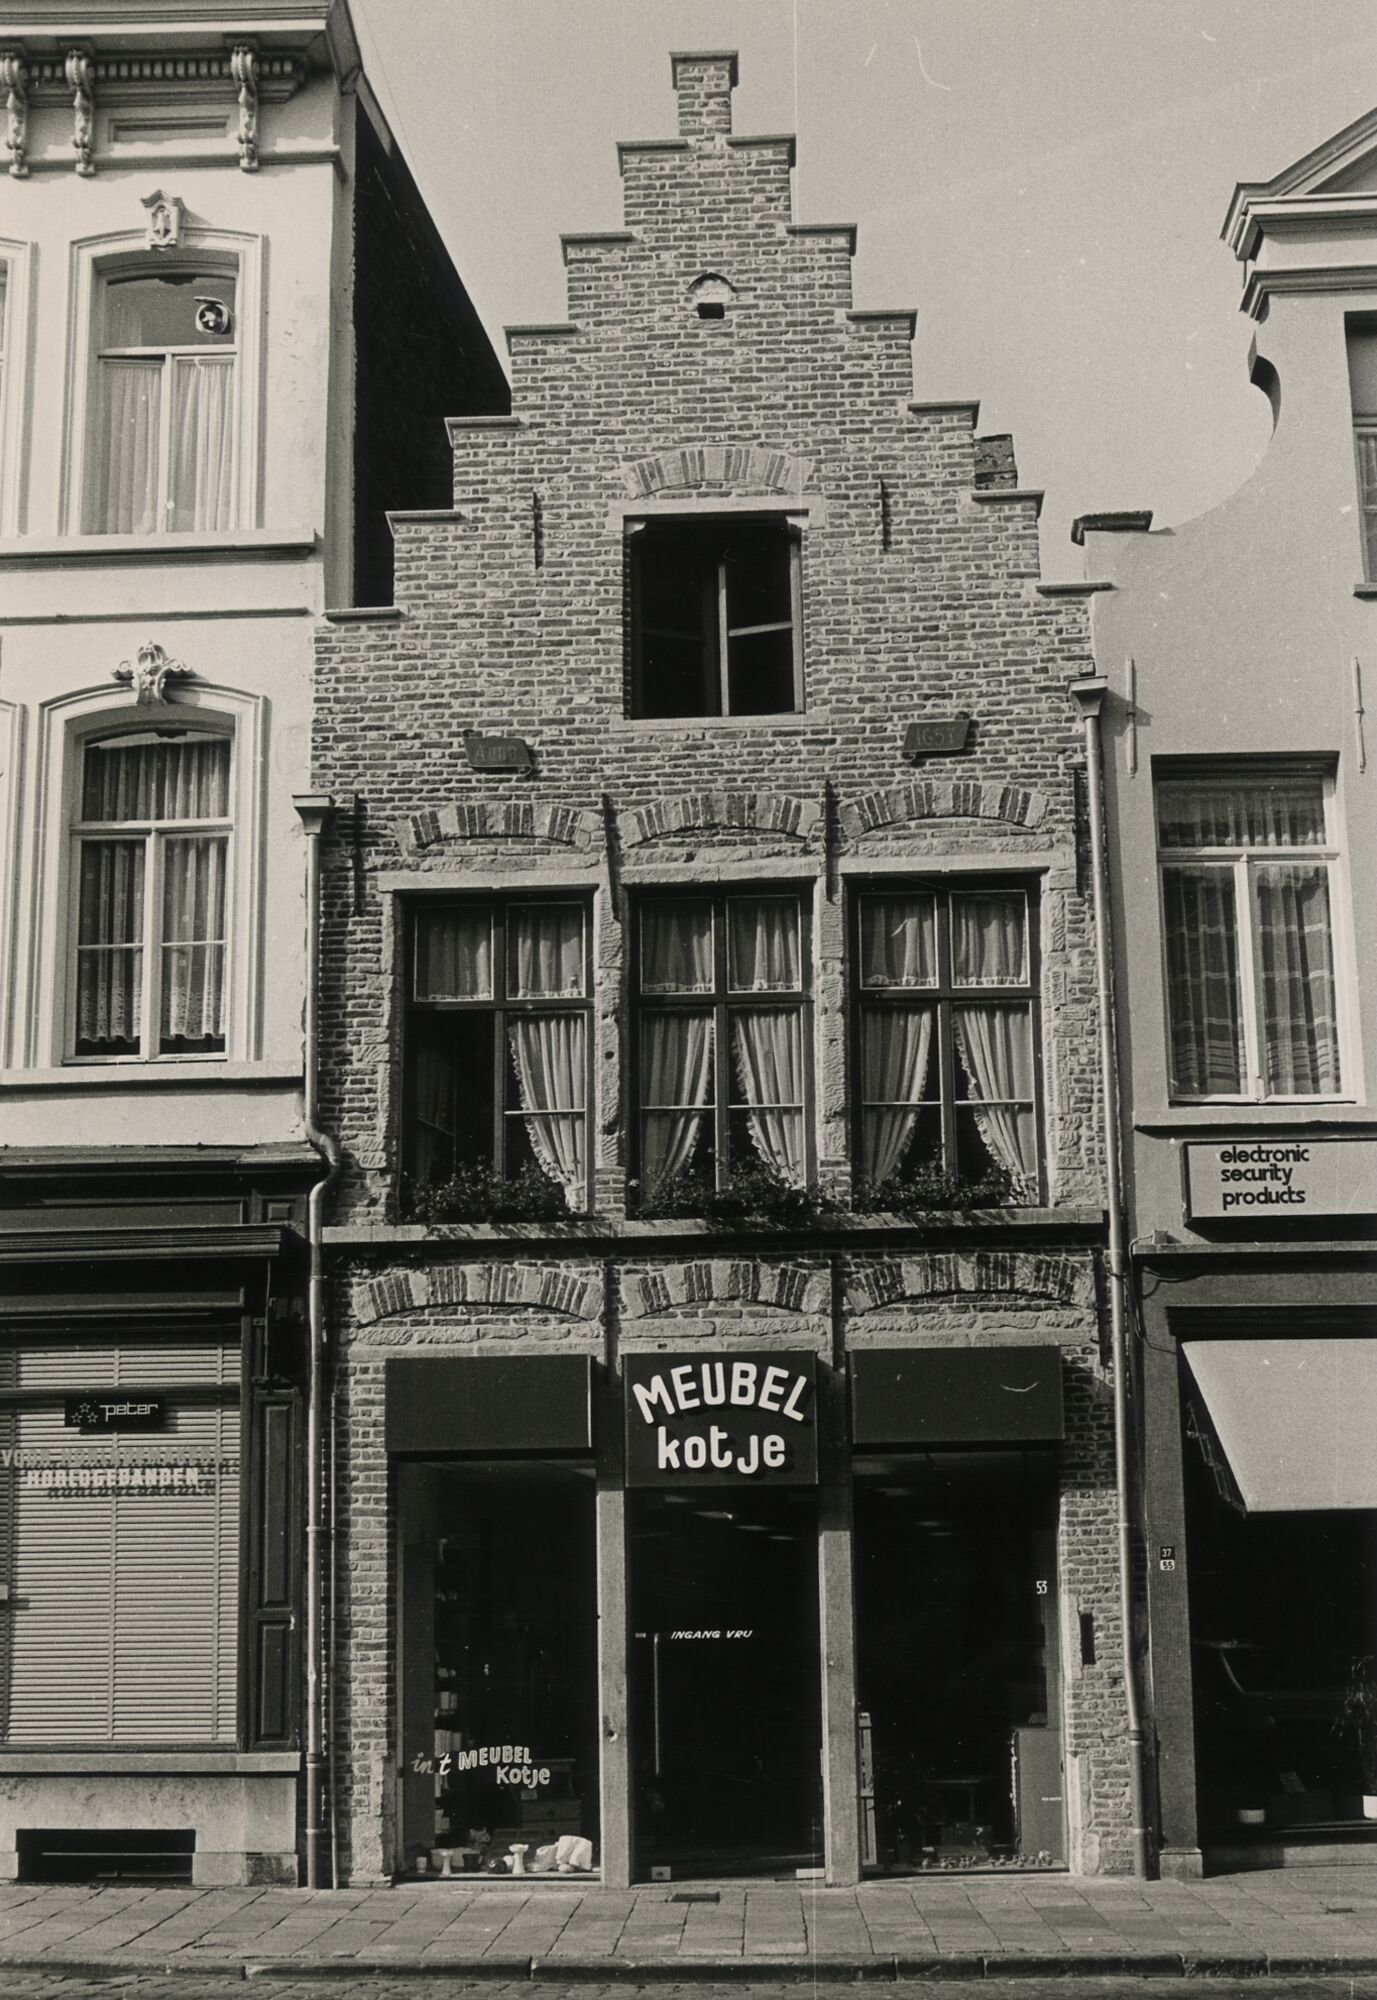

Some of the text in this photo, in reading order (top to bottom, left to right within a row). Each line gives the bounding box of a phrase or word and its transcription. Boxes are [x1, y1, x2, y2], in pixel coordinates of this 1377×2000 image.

[1220, 1144, 1310, 1164] electronic
[1221, 1163, 1293, 1186] security
[1222, 1186, 1306, 1211] products
[632, 1362, 807, 1424] MEUBEL
[99, 1401, 158, 1422] peter
[658, 1425, 786, 1475] kotje
[1162, 1548, 1172, 1557] 37
[1163, 1561, 1174, 1570] 55
[1036, 1580, 1048, 1594] 53
[671, 1631, 721, 1639] INGANG
[410, 1752, 434, 1774] in
[458, 1745, 532, 1771] MEUBEL
[496, 1765, 551, 1789] Kotje
